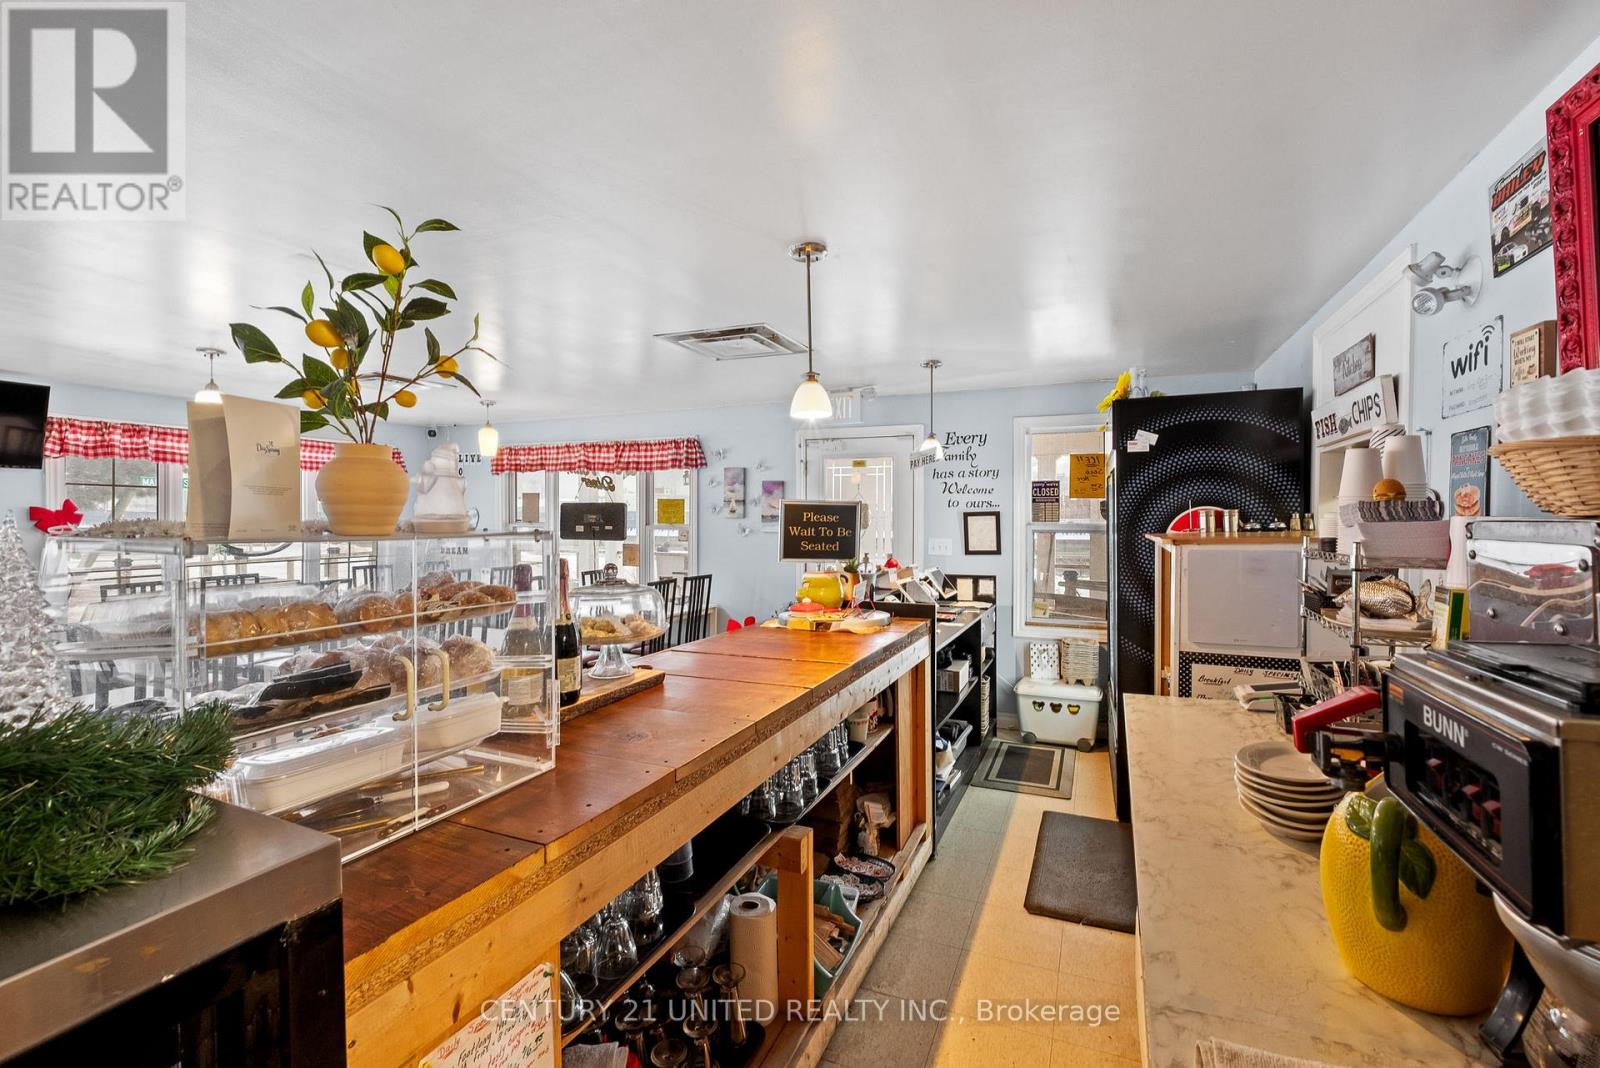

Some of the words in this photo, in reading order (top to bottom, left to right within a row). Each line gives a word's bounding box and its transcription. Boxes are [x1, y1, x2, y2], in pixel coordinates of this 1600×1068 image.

[1450, 335, 1490, 379] wifi
[1314, 412, 1338, 440] FISH
[1351, 392, 1382, 425] CHIPS
[944, 431, 987, 447] Every
[909, 458, 920, 470] PAY
[932, 468, 954, 480] has
[957, 470, 966, 478] a
[968, 468, 1000, 480] story
[940, 481, 994, 495] Welcome
[1032, 487, 1059, 497] CLOSED
[947, 498, 960, 508] to
[803, 511, 840, 523] Please
[788, 526, 817, 537] Wait
[818, 526, 833, 537] To
[837, 527, 853, 537] Be
[800, 541, 840, 552] Seated
